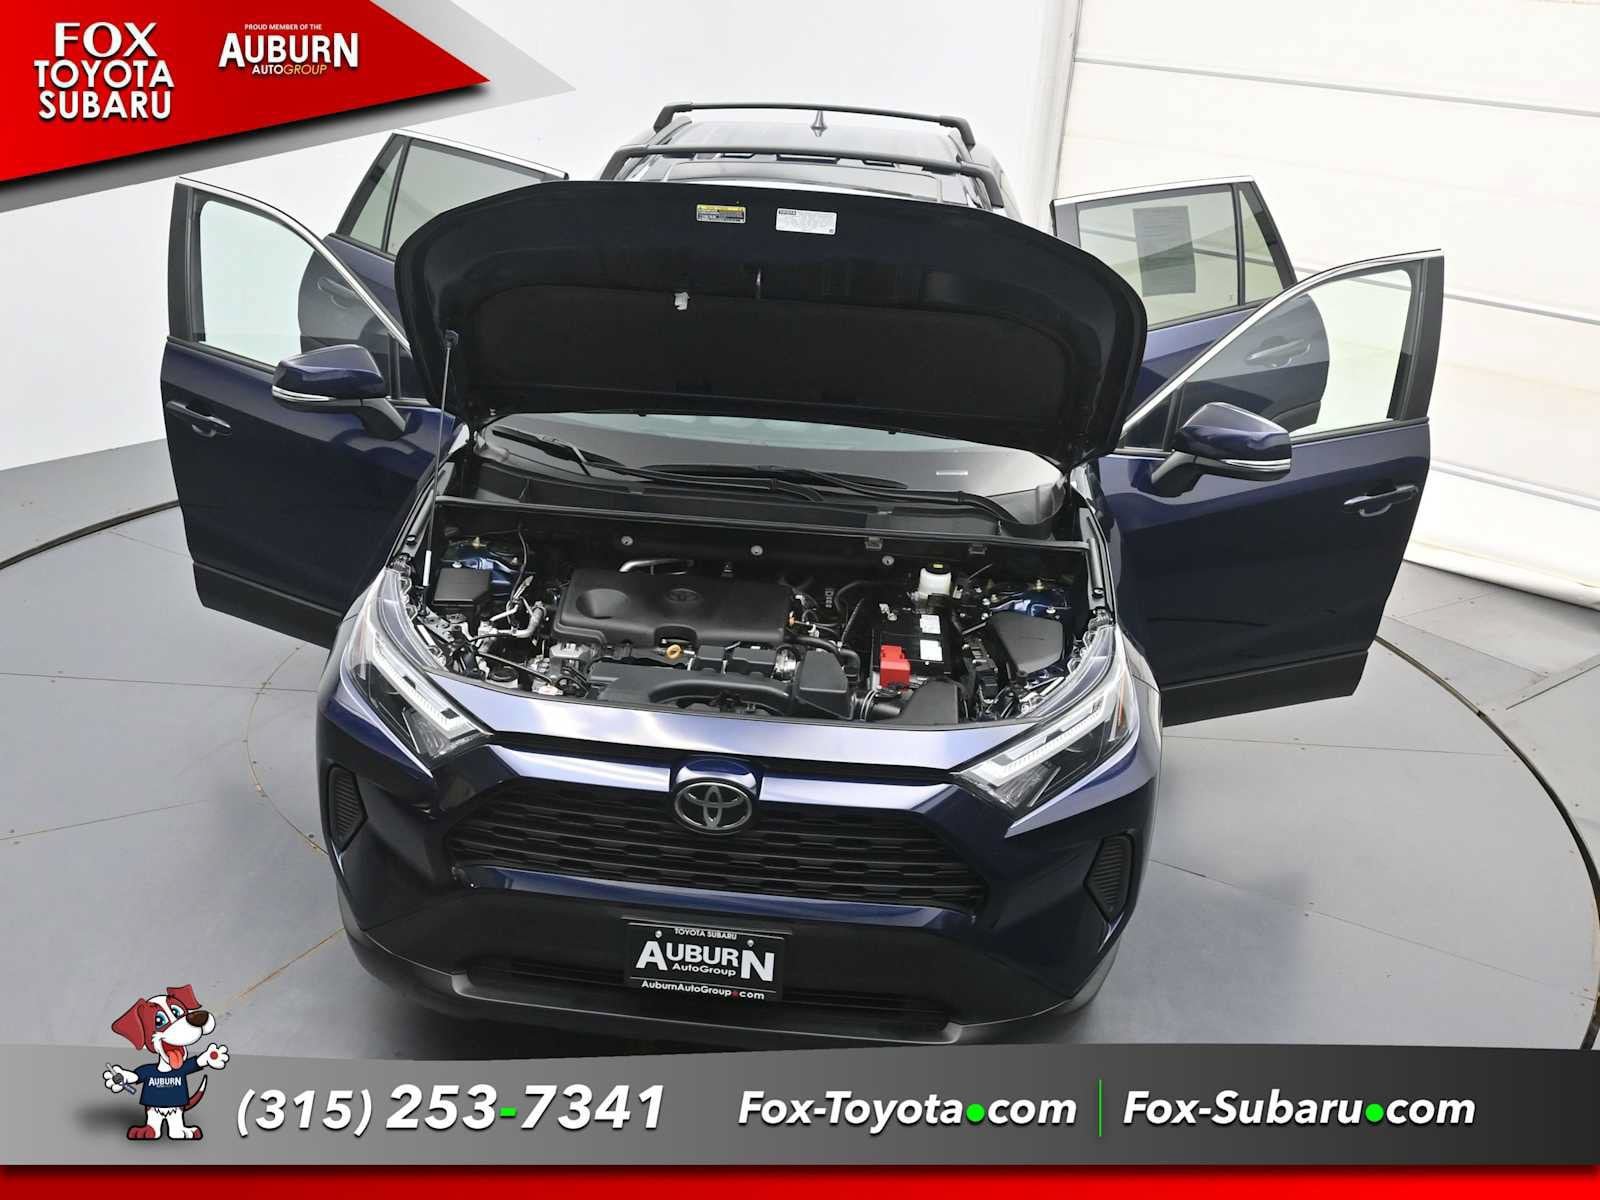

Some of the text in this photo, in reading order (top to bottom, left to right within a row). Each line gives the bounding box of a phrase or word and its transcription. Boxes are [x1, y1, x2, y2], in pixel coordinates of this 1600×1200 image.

[674, 927, 737, 940] TOYOTA SUBARU
[635, 940, 775, 982] AUBURN
[672, 963, 737, 977] AutoGroup
